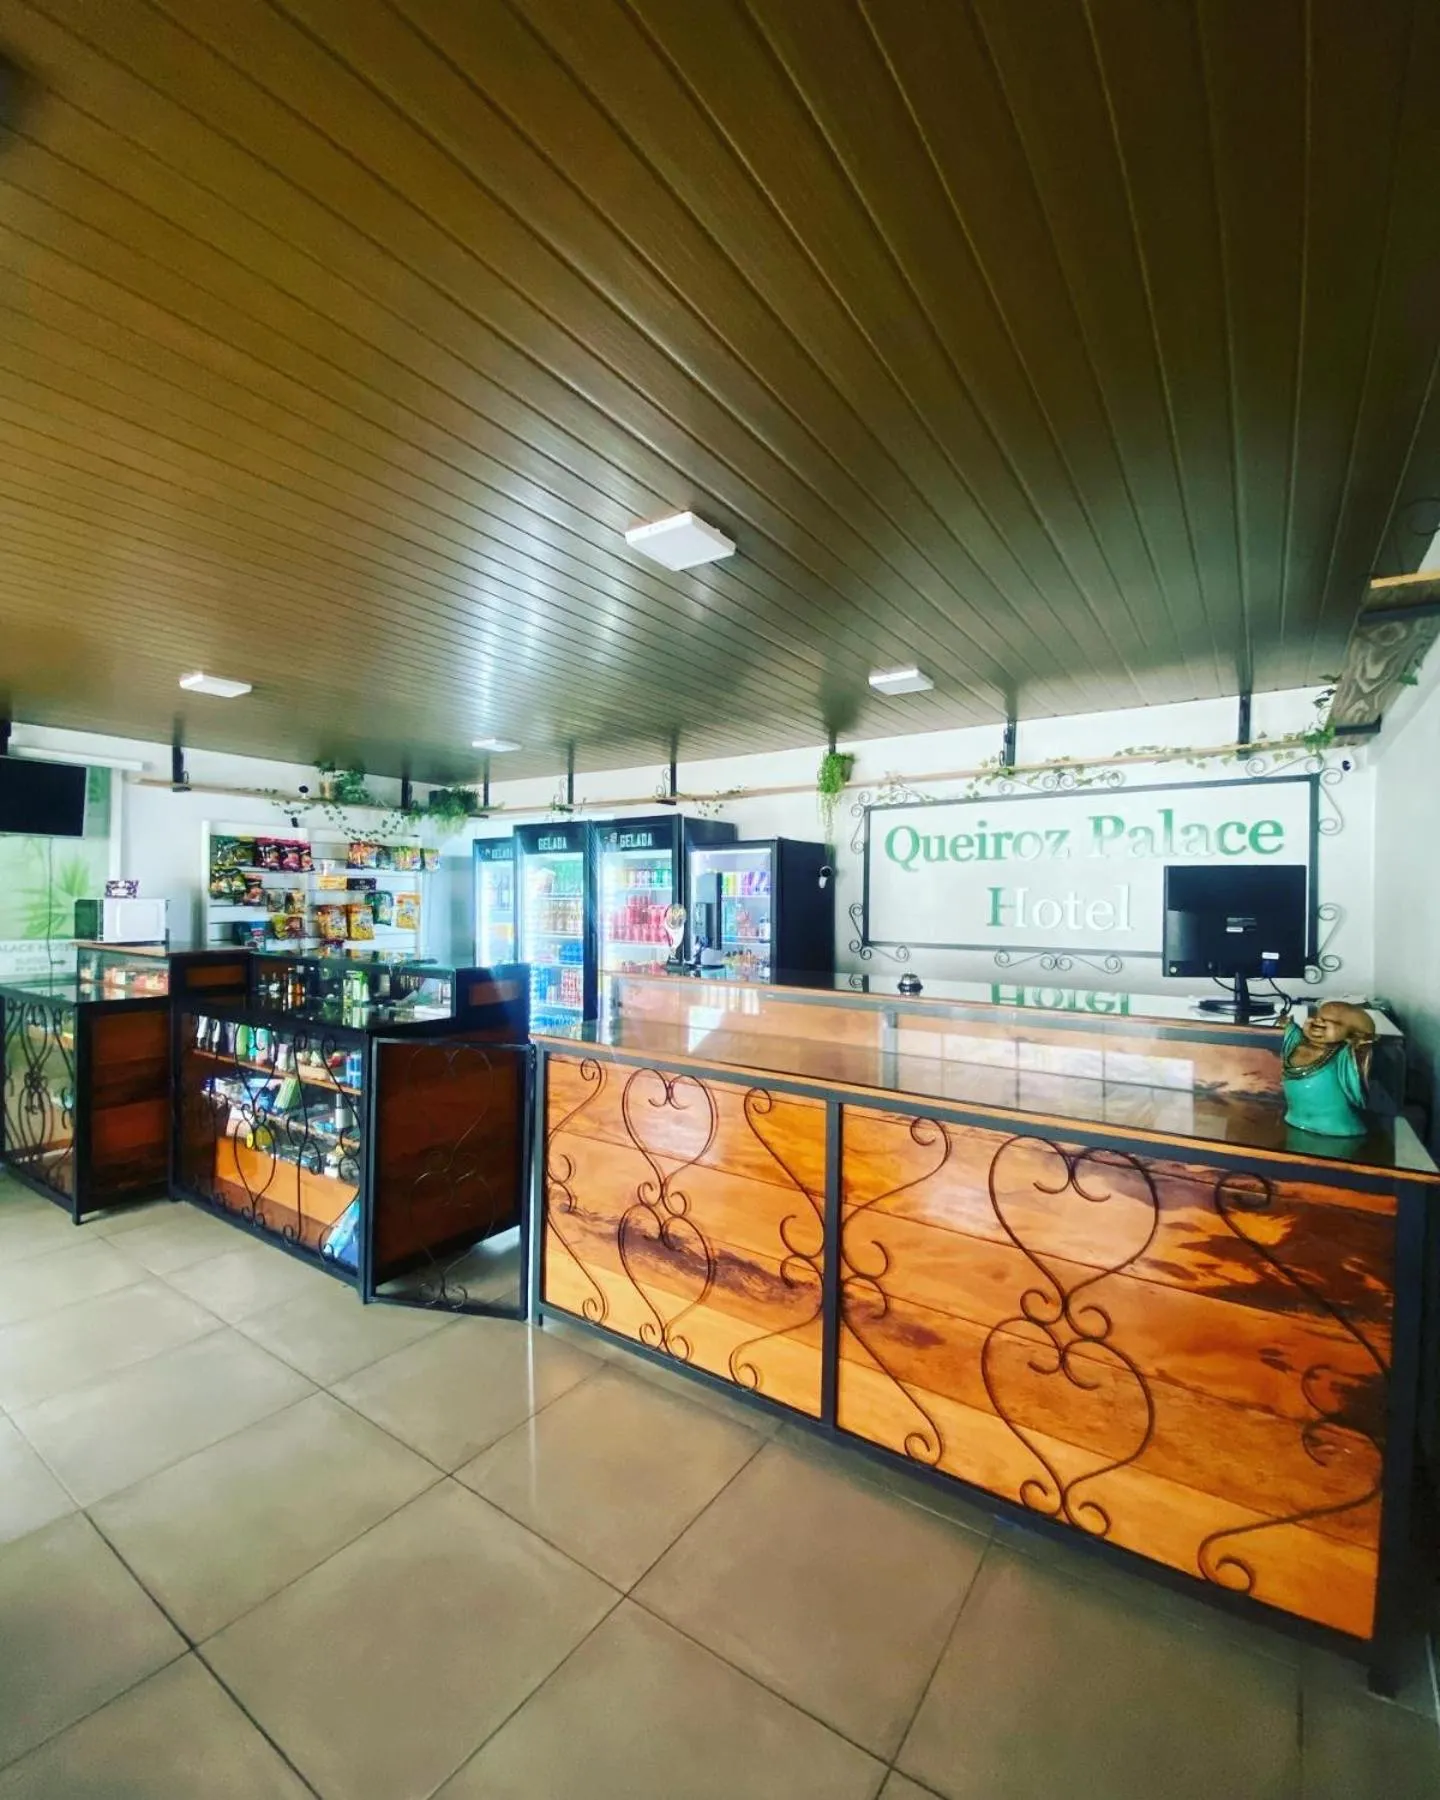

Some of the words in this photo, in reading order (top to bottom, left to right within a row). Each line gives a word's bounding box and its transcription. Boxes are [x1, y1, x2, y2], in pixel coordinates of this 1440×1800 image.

[538, 836, 568, 851] GELADA
[620, 832, 653, 848] GELADA
[885, 820, 1071, 872] Queiroz
[1086, 808, 1284, 858] Palace
[986, 884, 1134, 931] Hotel
